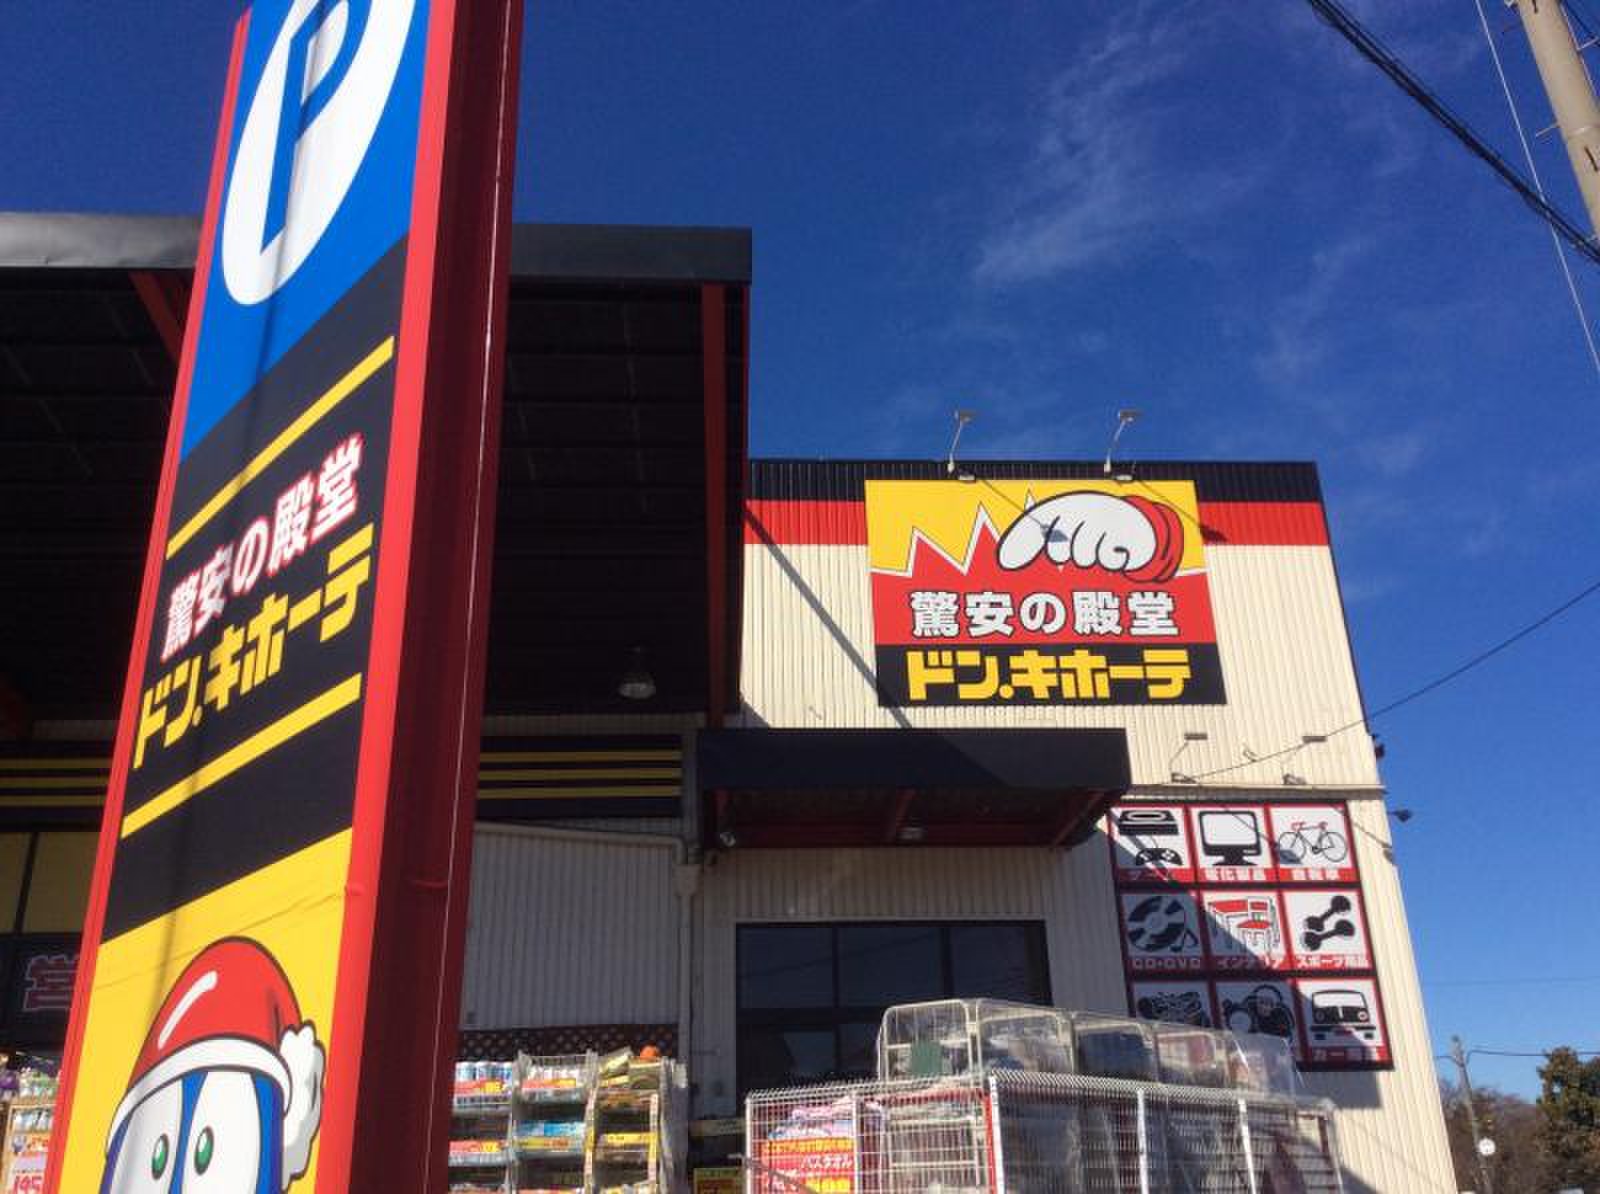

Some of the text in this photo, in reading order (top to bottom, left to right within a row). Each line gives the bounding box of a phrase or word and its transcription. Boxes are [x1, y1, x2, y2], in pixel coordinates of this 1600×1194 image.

[260, 0, 374, 256] P
[160, 433, 364, 662] 驚安の殿堂
[910, 591, 1179, 638] 驚安の殿堂
